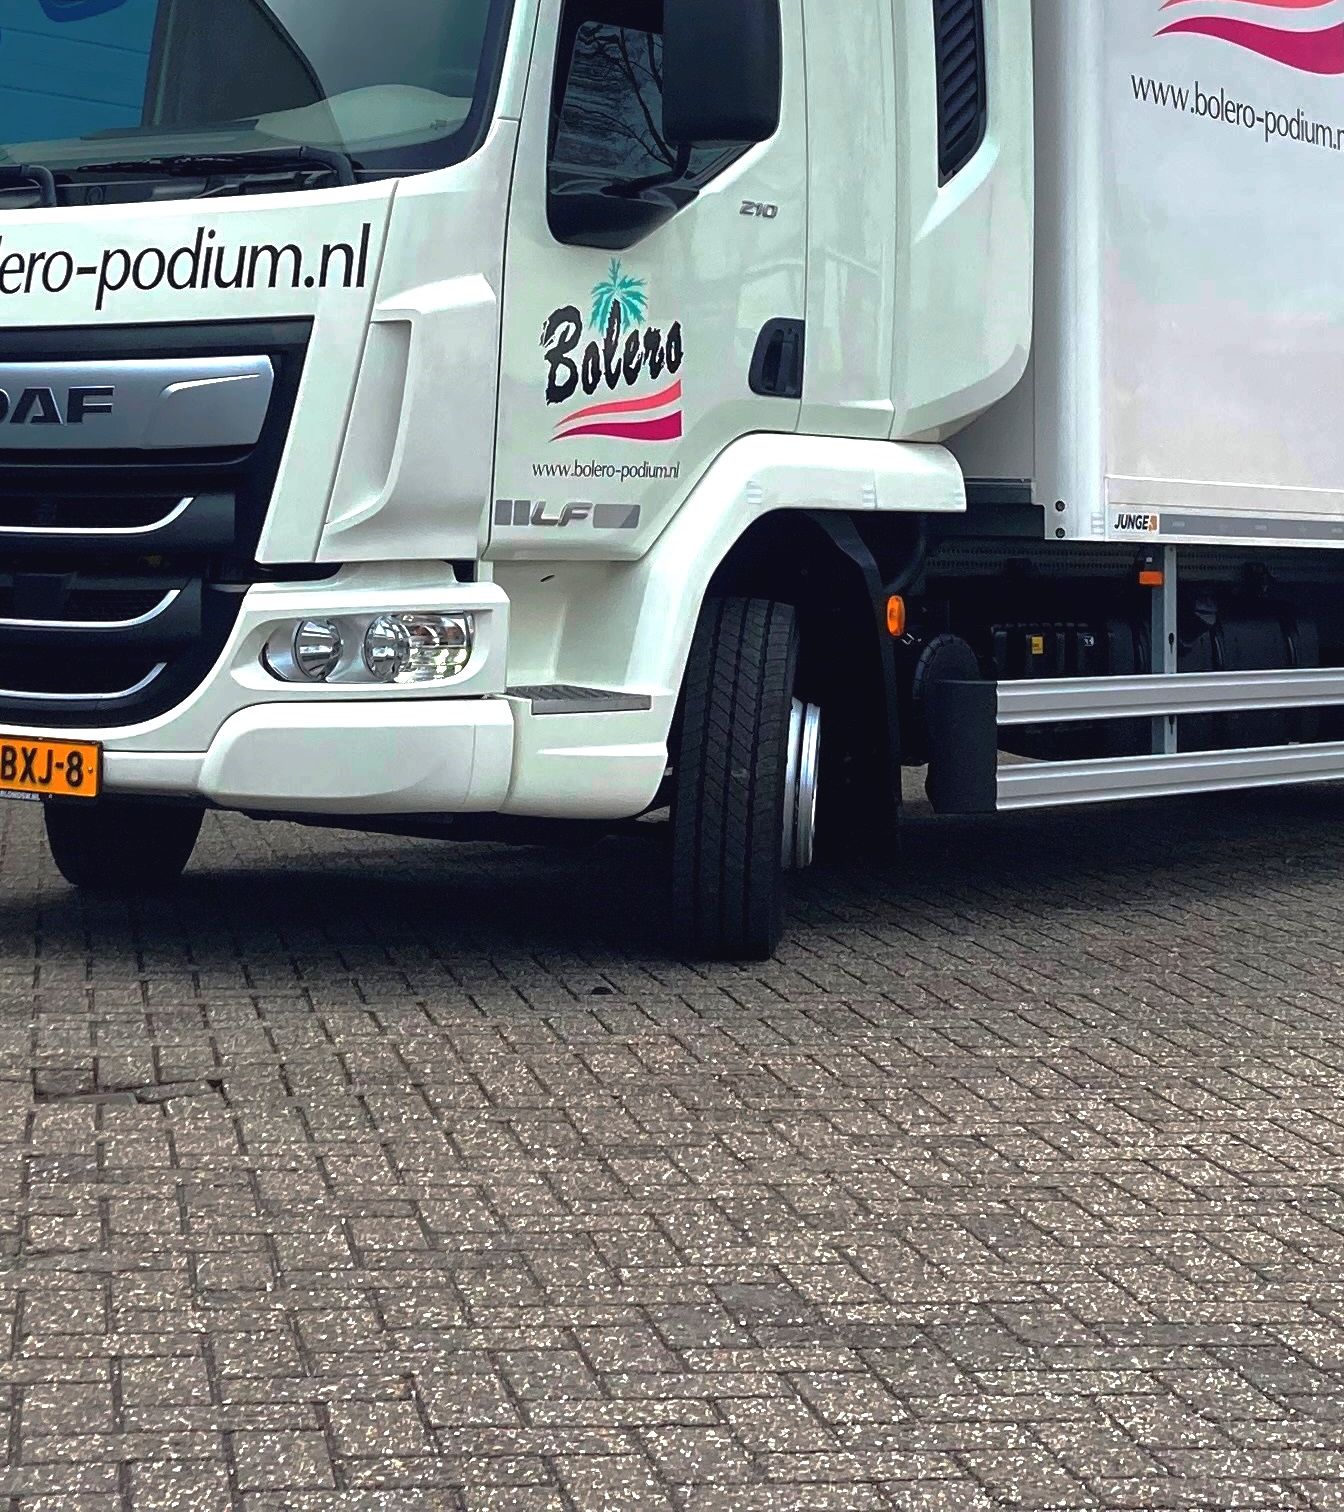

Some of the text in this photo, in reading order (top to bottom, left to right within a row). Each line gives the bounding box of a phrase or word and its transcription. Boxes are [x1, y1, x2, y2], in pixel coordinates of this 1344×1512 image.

[739, 200, 778, 219] 210
[538, 298, 685, 406] Bolero
[532, 458, 681, 483] www.bolero-podium.nl
[529, 501, 594, 526] LF
[1114, 514, 1150, 530] JUNGE
